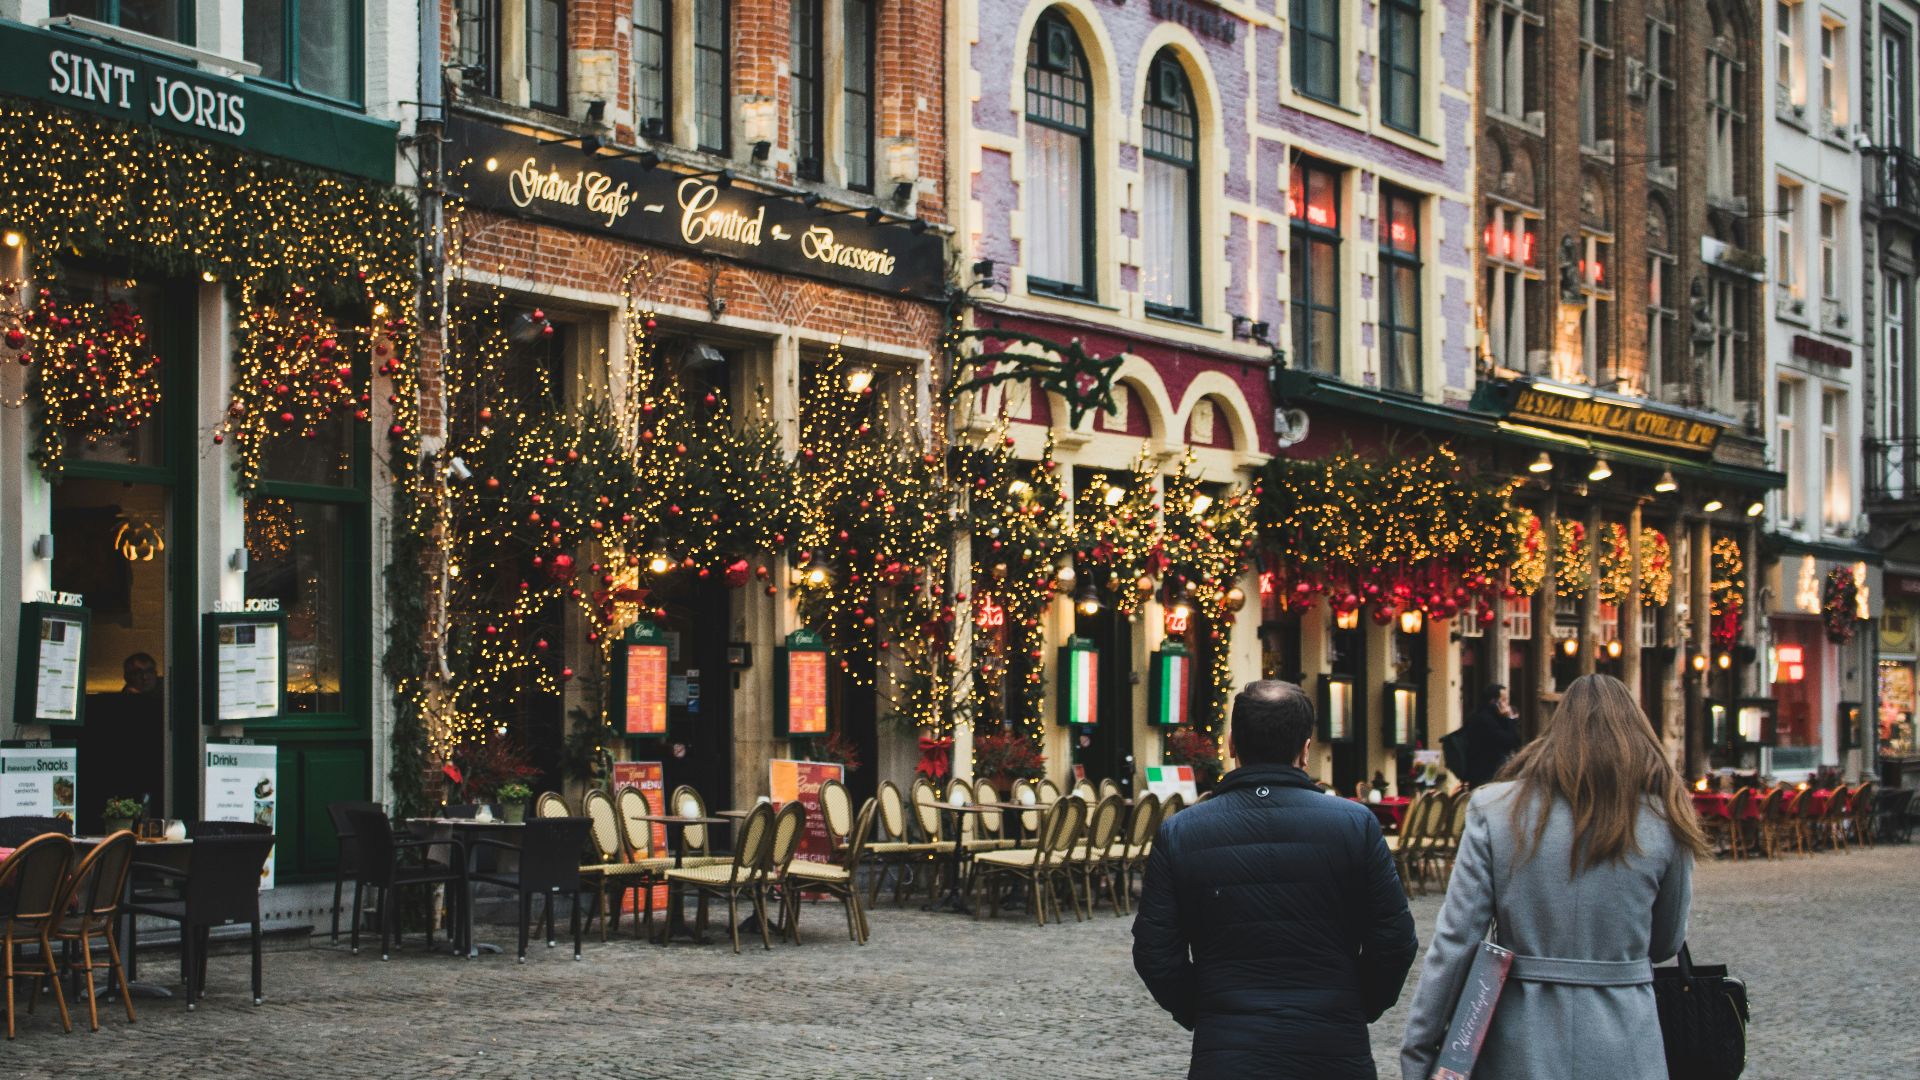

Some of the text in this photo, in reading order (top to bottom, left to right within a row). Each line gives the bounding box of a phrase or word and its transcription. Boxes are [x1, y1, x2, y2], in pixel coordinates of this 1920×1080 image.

[50, 50, 246, 136] SINT JORIS
[509, 157, 583, 207] Grand
[677, 177, 765, 246] Central
[801, 224, 896, 276] Brasserie
[36, 590, 83, 607] SINT JORIS
[245, 598, 280, 612] JORIS
[37, 759, 69, 772] Snacks
[212, 754, 238, 767] Drinks
